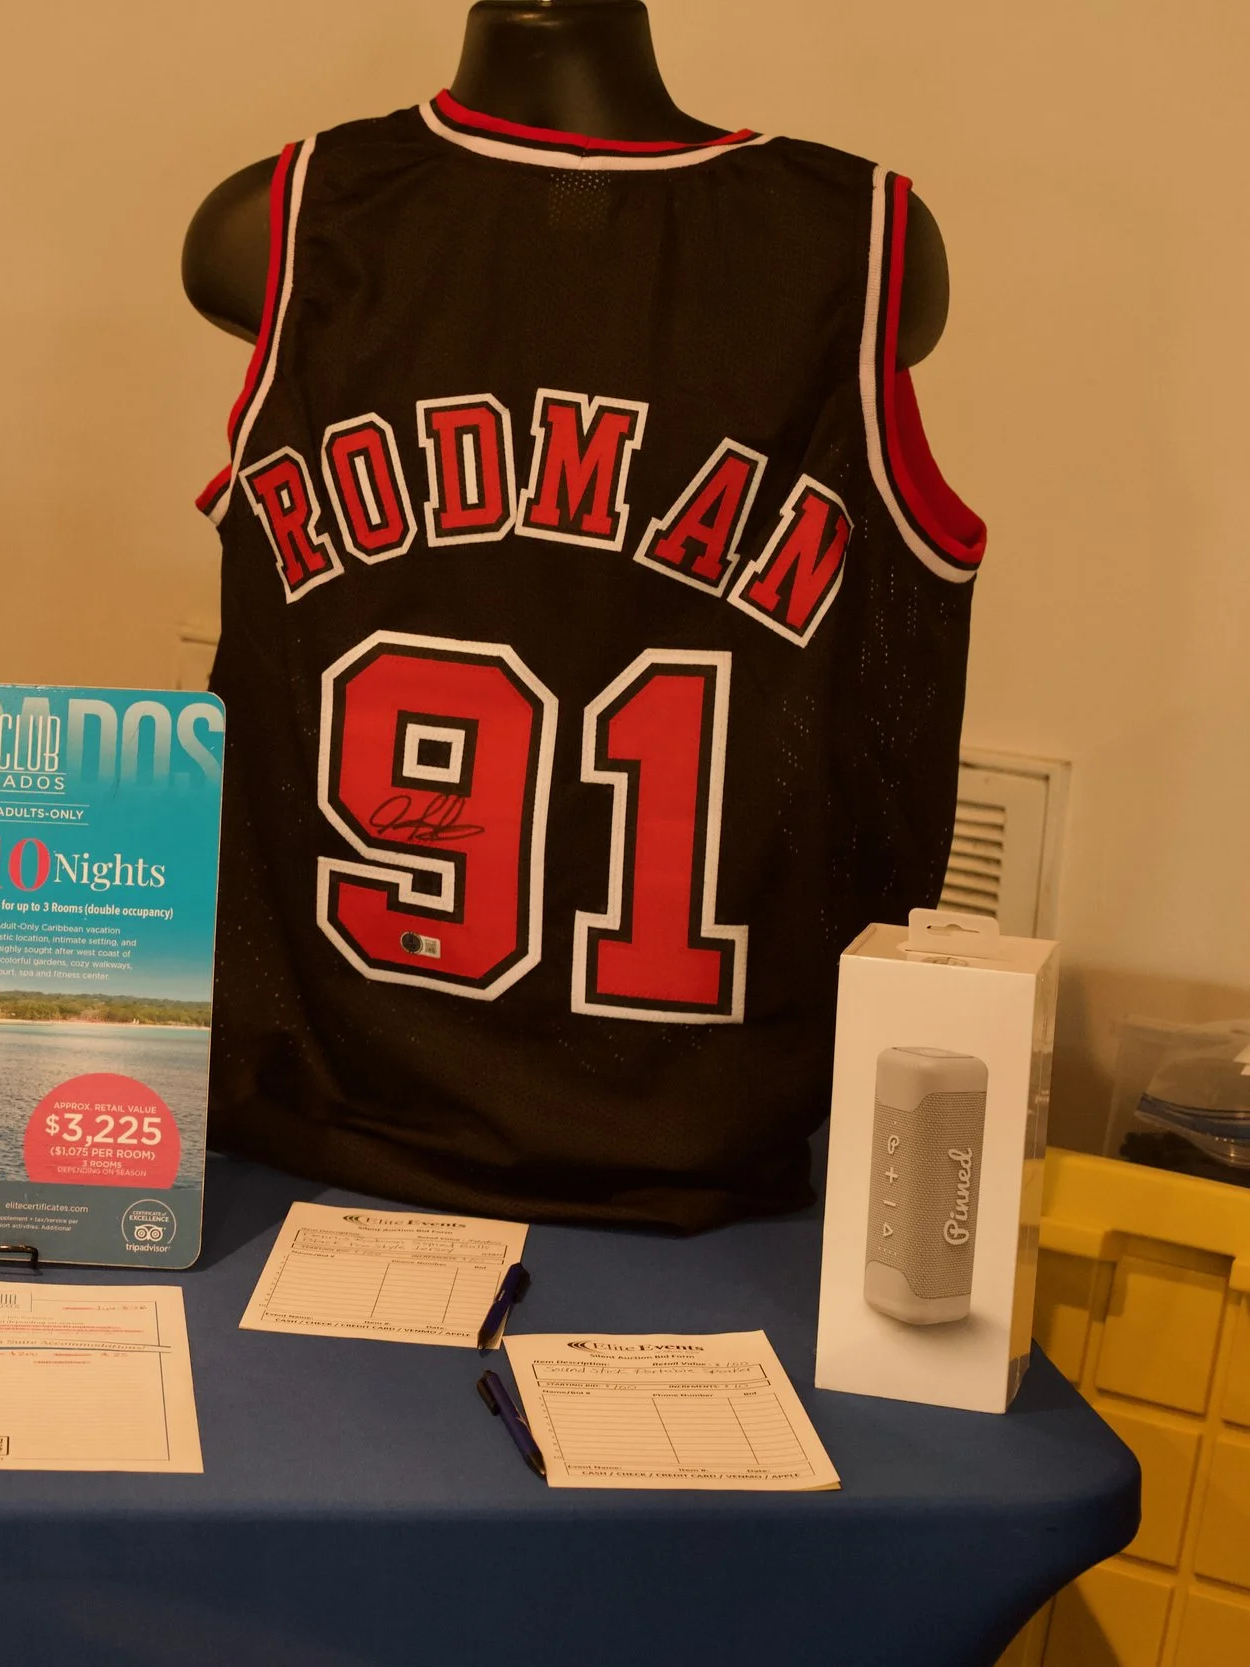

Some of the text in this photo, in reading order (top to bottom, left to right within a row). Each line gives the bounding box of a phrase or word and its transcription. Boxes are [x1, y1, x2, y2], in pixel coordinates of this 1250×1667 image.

[239, 388, 854, 648] RODMAN
[316, 630, 749, 1024] 91
[54, 852, 165, 892] Nights
[2, 899, 14, 910] for
[16, 902, 28, 914] up
[30, 900, 40, 911] to
[43, 901, 49, 912] 3
[51, 901, 83, 913] Rooms
[84, 903, 120, 916] (double
[122, 906, 174, 920] occupancy)
[42, 923, 84, 932] Caribbean
[86, 926, 120, 934] vacation
[15, 934, 50, 945] location,
[52, 935, 86, 944] intimate
[88, 937, 118, 948] setting,
[24, 946, 52, 956] sought
[54, 947, 74, 955] after
[0, 956, 30, 964] colorful
[70, 960, 90, 969] cozy
[92, 960, 133, 971] walkways,
[18, 969, 34, 978] spa
[53, 969, 80, 978] fitness
[54, 1102, 157, 1114] APPROX. RETAIL VALUE
[45, 1113, 162, 1147] $3,225
[50, 1147, 156, 1160] ($1,075 PER ROOM)
[58, 1166, 101, 1175] DEPENDING
[944, 1148, 973, 1246] Pinned
[5, 1202, 88, 1213] elitecertificates.com
[126, 1243, 168, 1252] tripadvisor
[593, 1342, 635, 1351] Elite
